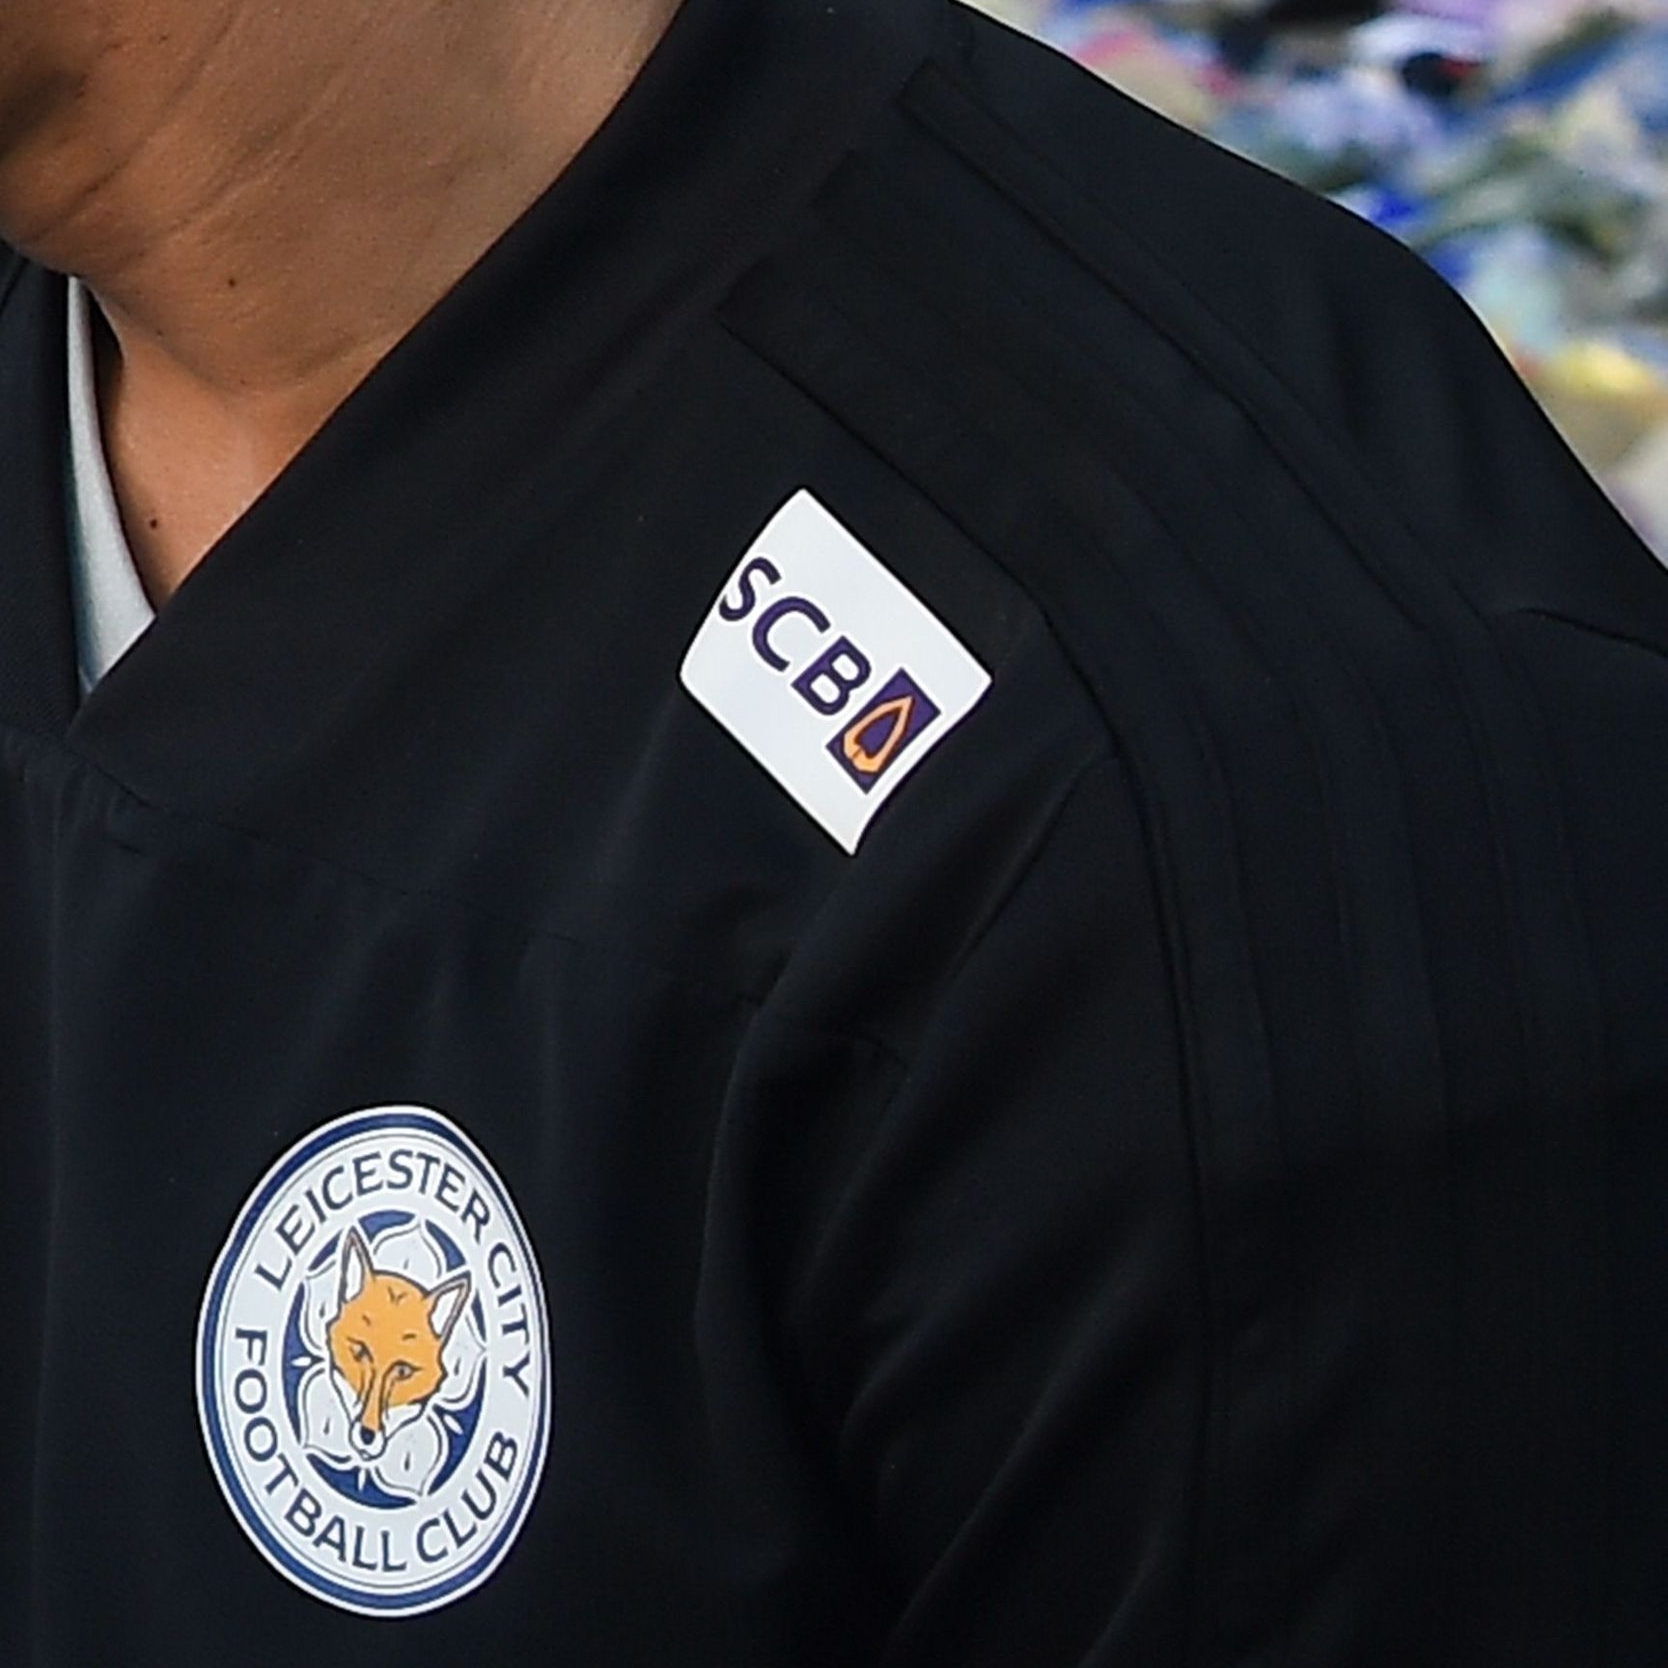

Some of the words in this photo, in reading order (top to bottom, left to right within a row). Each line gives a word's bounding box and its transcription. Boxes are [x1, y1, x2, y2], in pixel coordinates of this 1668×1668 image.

[718, 556, 872, 717] SCB
[254, 1147, 492, 1293] LEICESTER
[486, 1241, 532, 1400] CITY
[233, 1326, 408, 1574] FOOTBALL
[415, 1429, 519, 1564] CLUB
